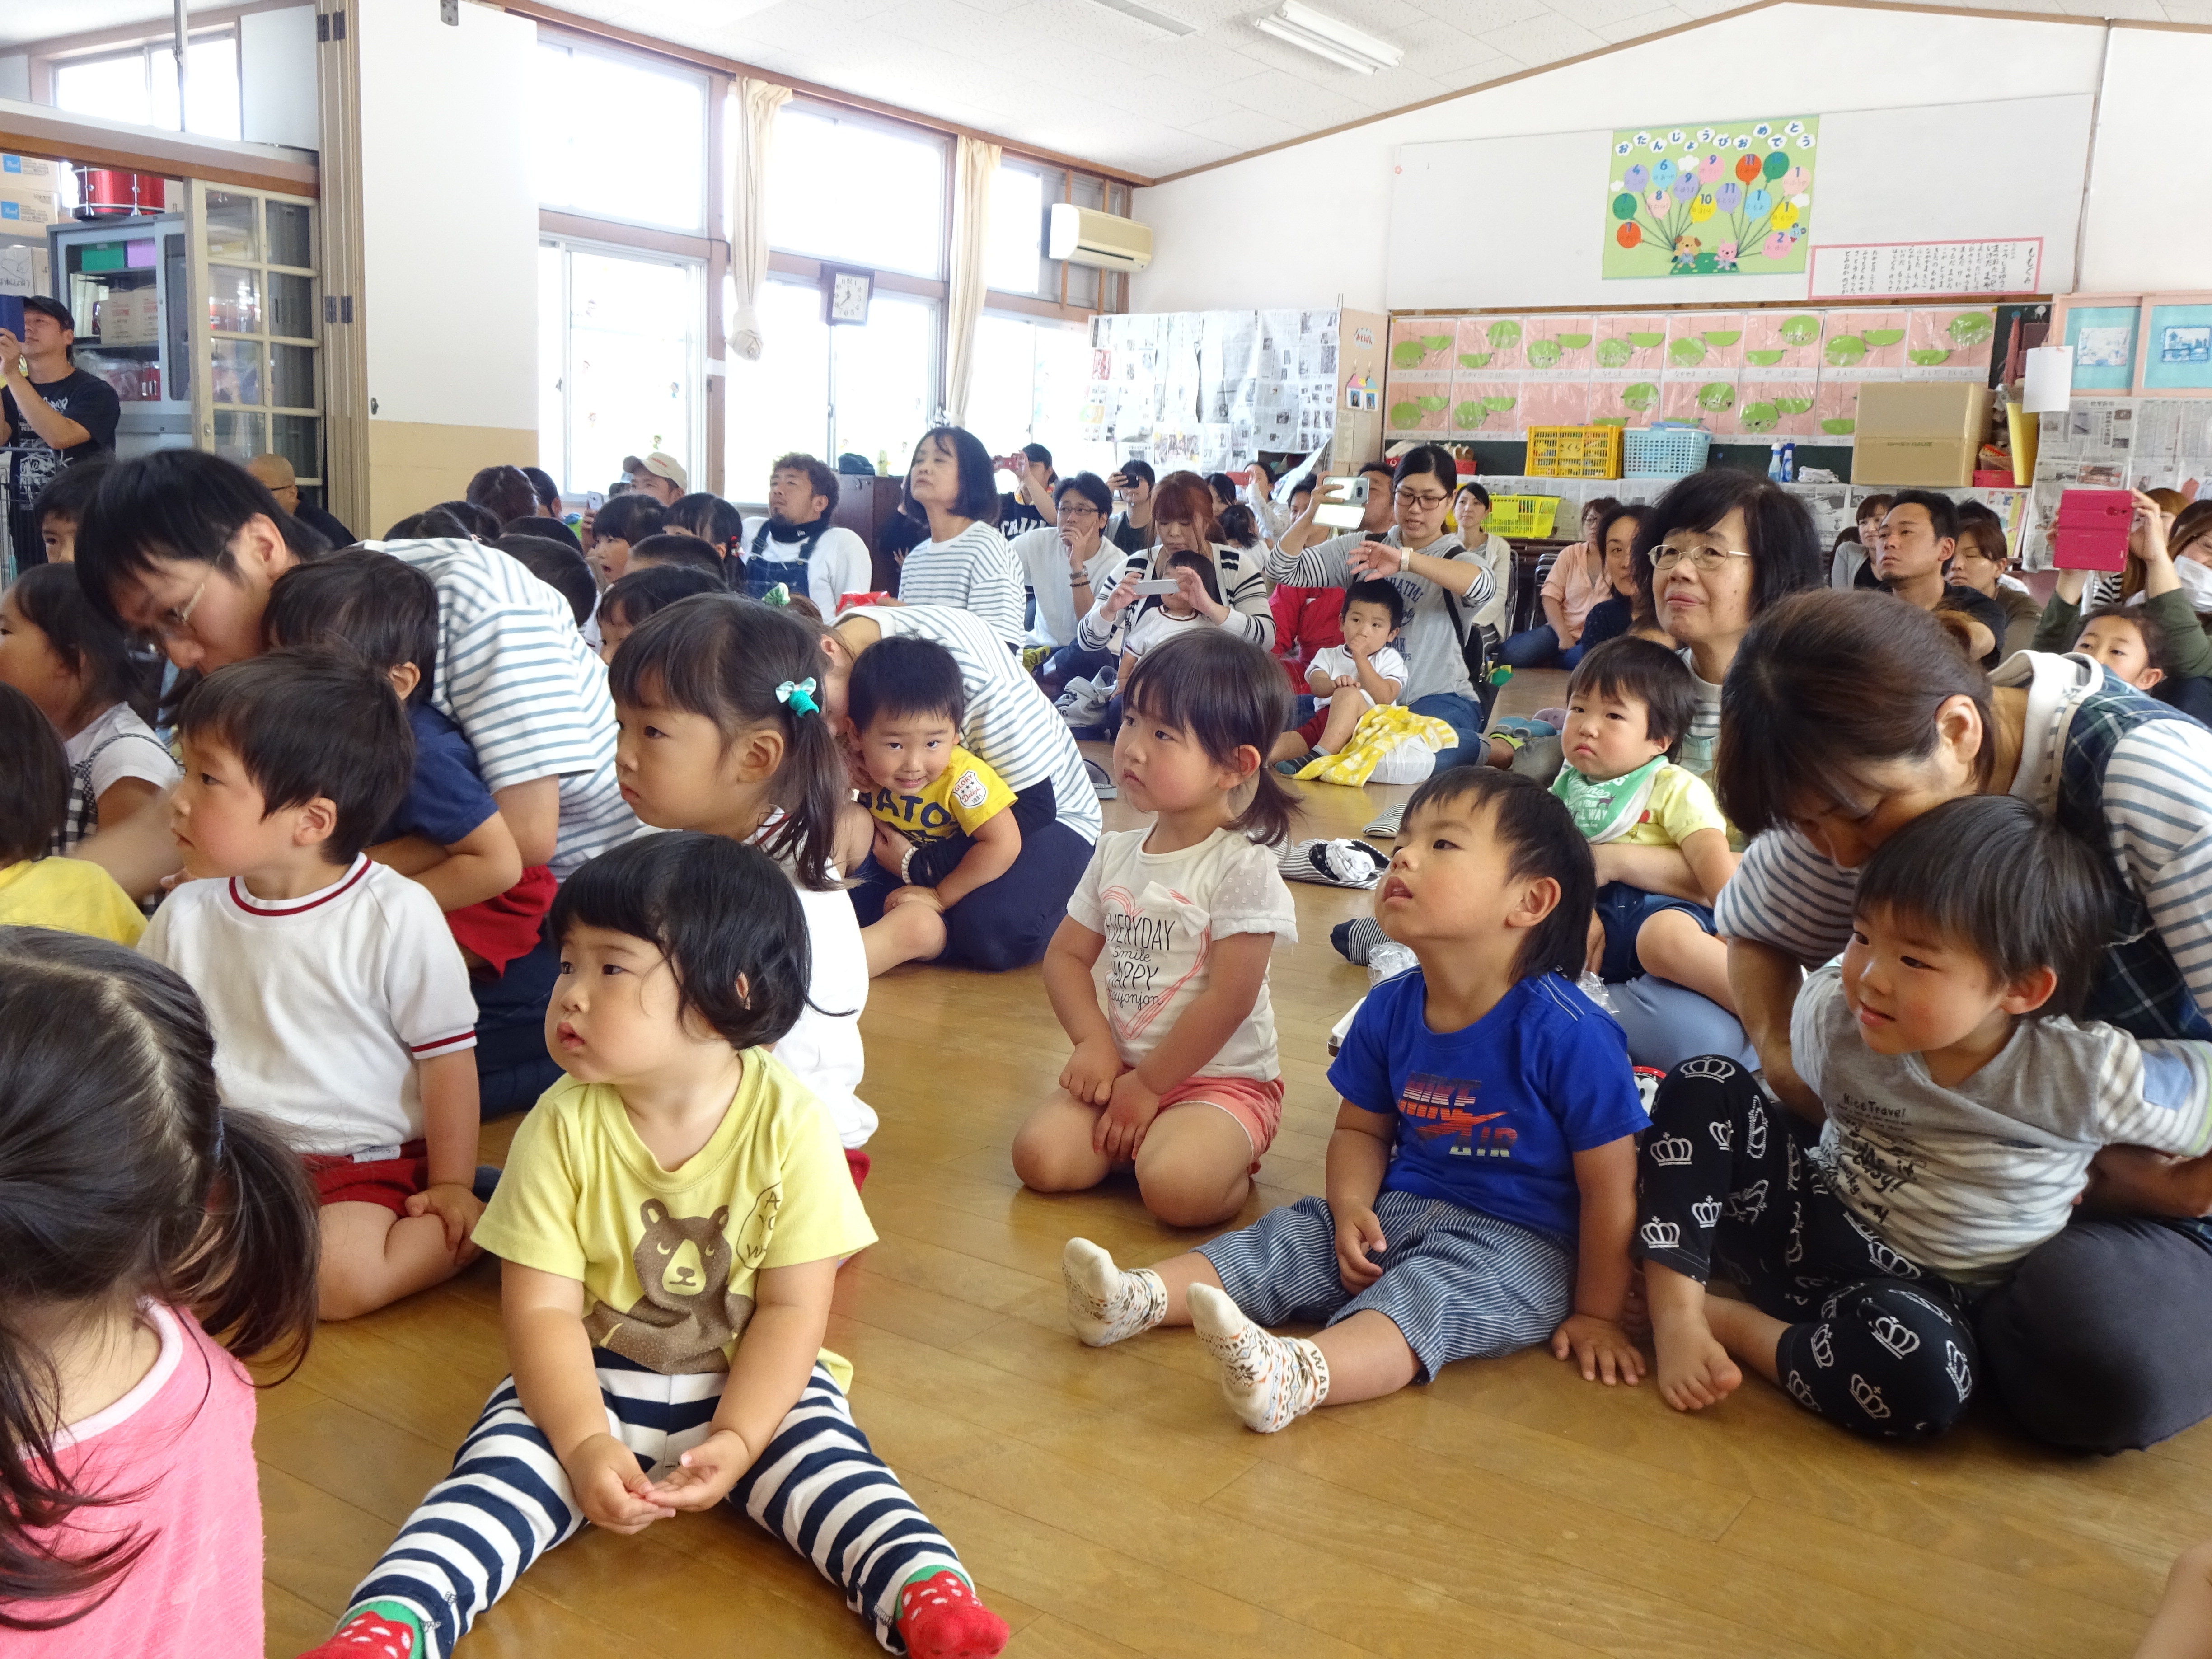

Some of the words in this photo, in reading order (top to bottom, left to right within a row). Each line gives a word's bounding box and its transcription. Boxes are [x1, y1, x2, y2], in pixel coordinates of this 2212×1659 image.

[1632, 164, 1640, 175] 4
[1660, 159, 1668, 170] 6
[1655, 190, 1662, 200] 8
[1777, 232, 1785, 243] 2
[1559, 443, 1581, 452] さくら
[955, 773, 973, 792] GLORY
[961, 785, 982, 803] Delight
[971, 794, 983, 804] 1985
[1588, 809, 1608, 821] WAY
[1106, 912, 1176, 951] EVERYDAY
[1113, 946, 1152, 962] Smile
[1108, 960, 1159, 990] HAPPY
[1868, 1099, 1907, 1118] Travel
